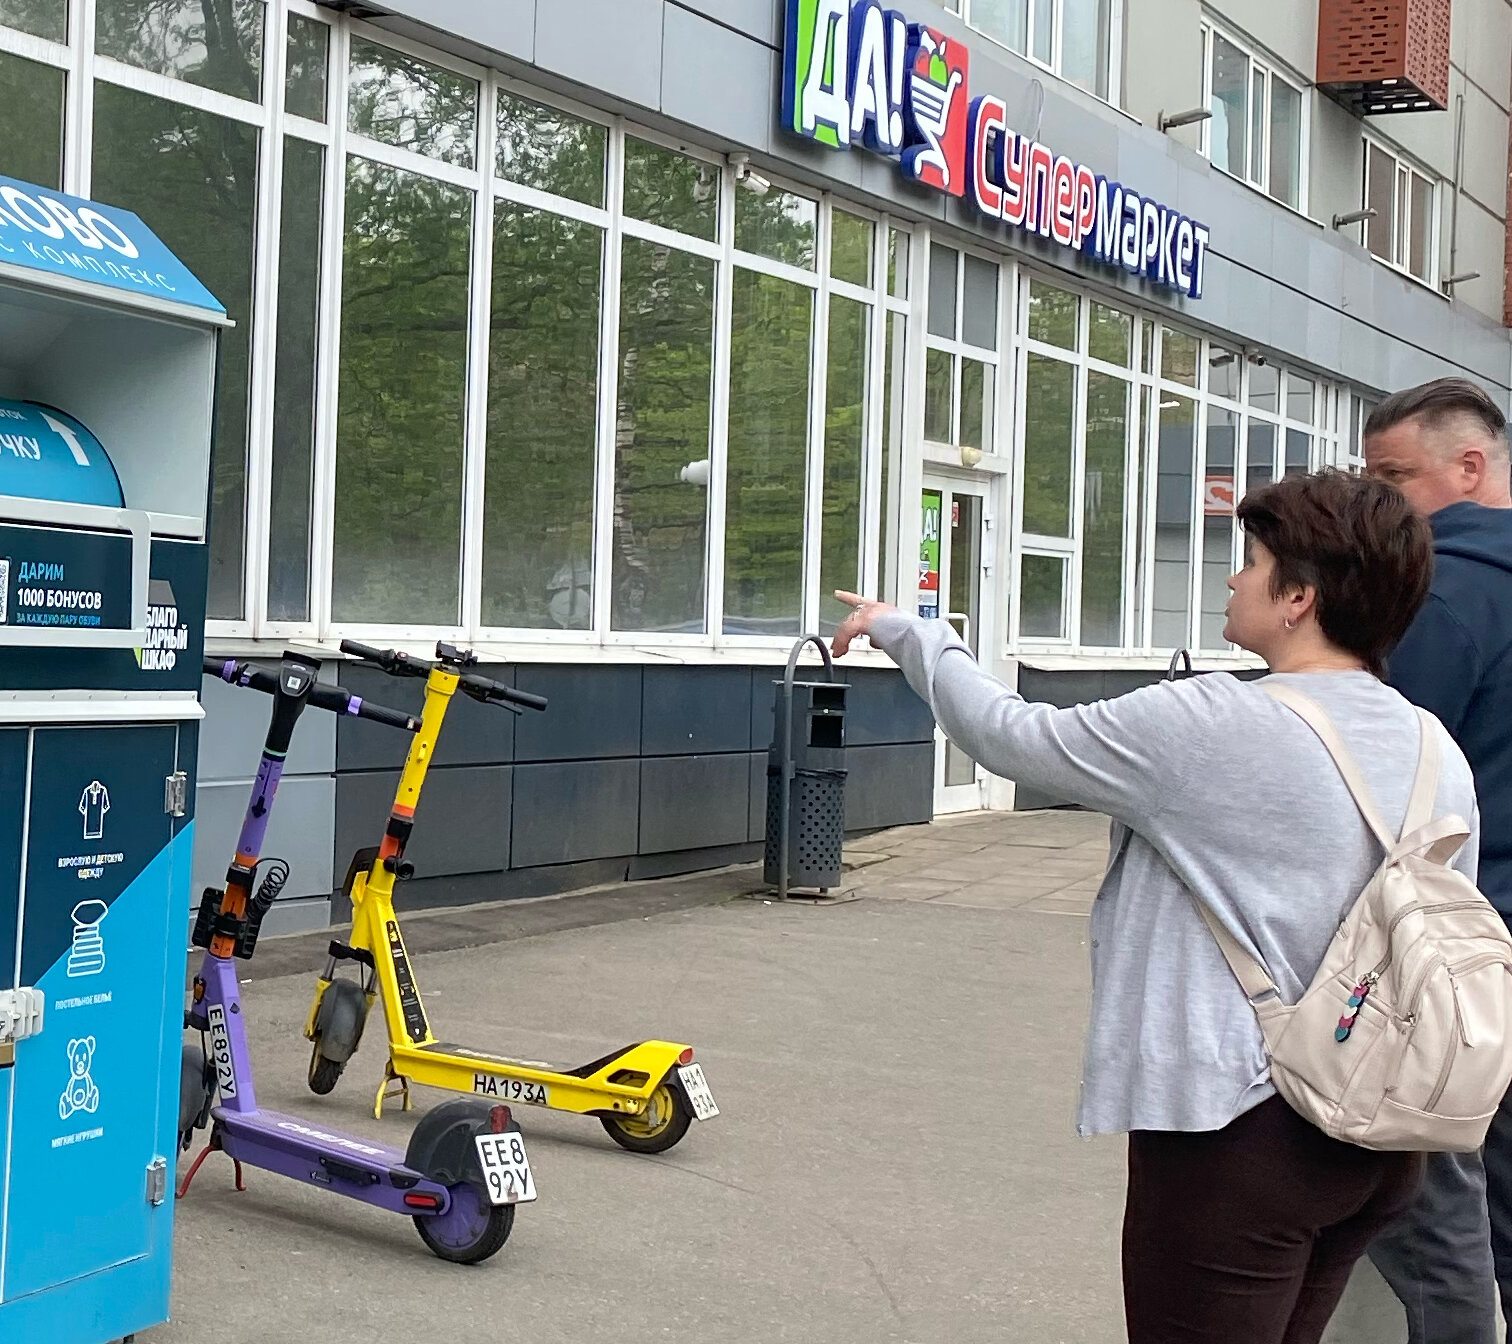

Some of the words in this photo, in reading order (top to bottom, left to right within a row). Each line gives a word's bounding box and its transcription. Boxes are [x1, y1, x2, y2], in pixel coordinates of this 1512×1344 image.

[22, 239, 176, 292] КОМПЛЕКС
[18, 562, 64, 583] ДАРИМ
[17, 588, 44, 607] 1000
[46, 589, 102, 609] БОНУСОВ
[146, 607, 178, 628] БЛАГО
[145, 624, 188, 650] ДАРНЫЙ
[141, 649, 176, 670] ШКАФ
